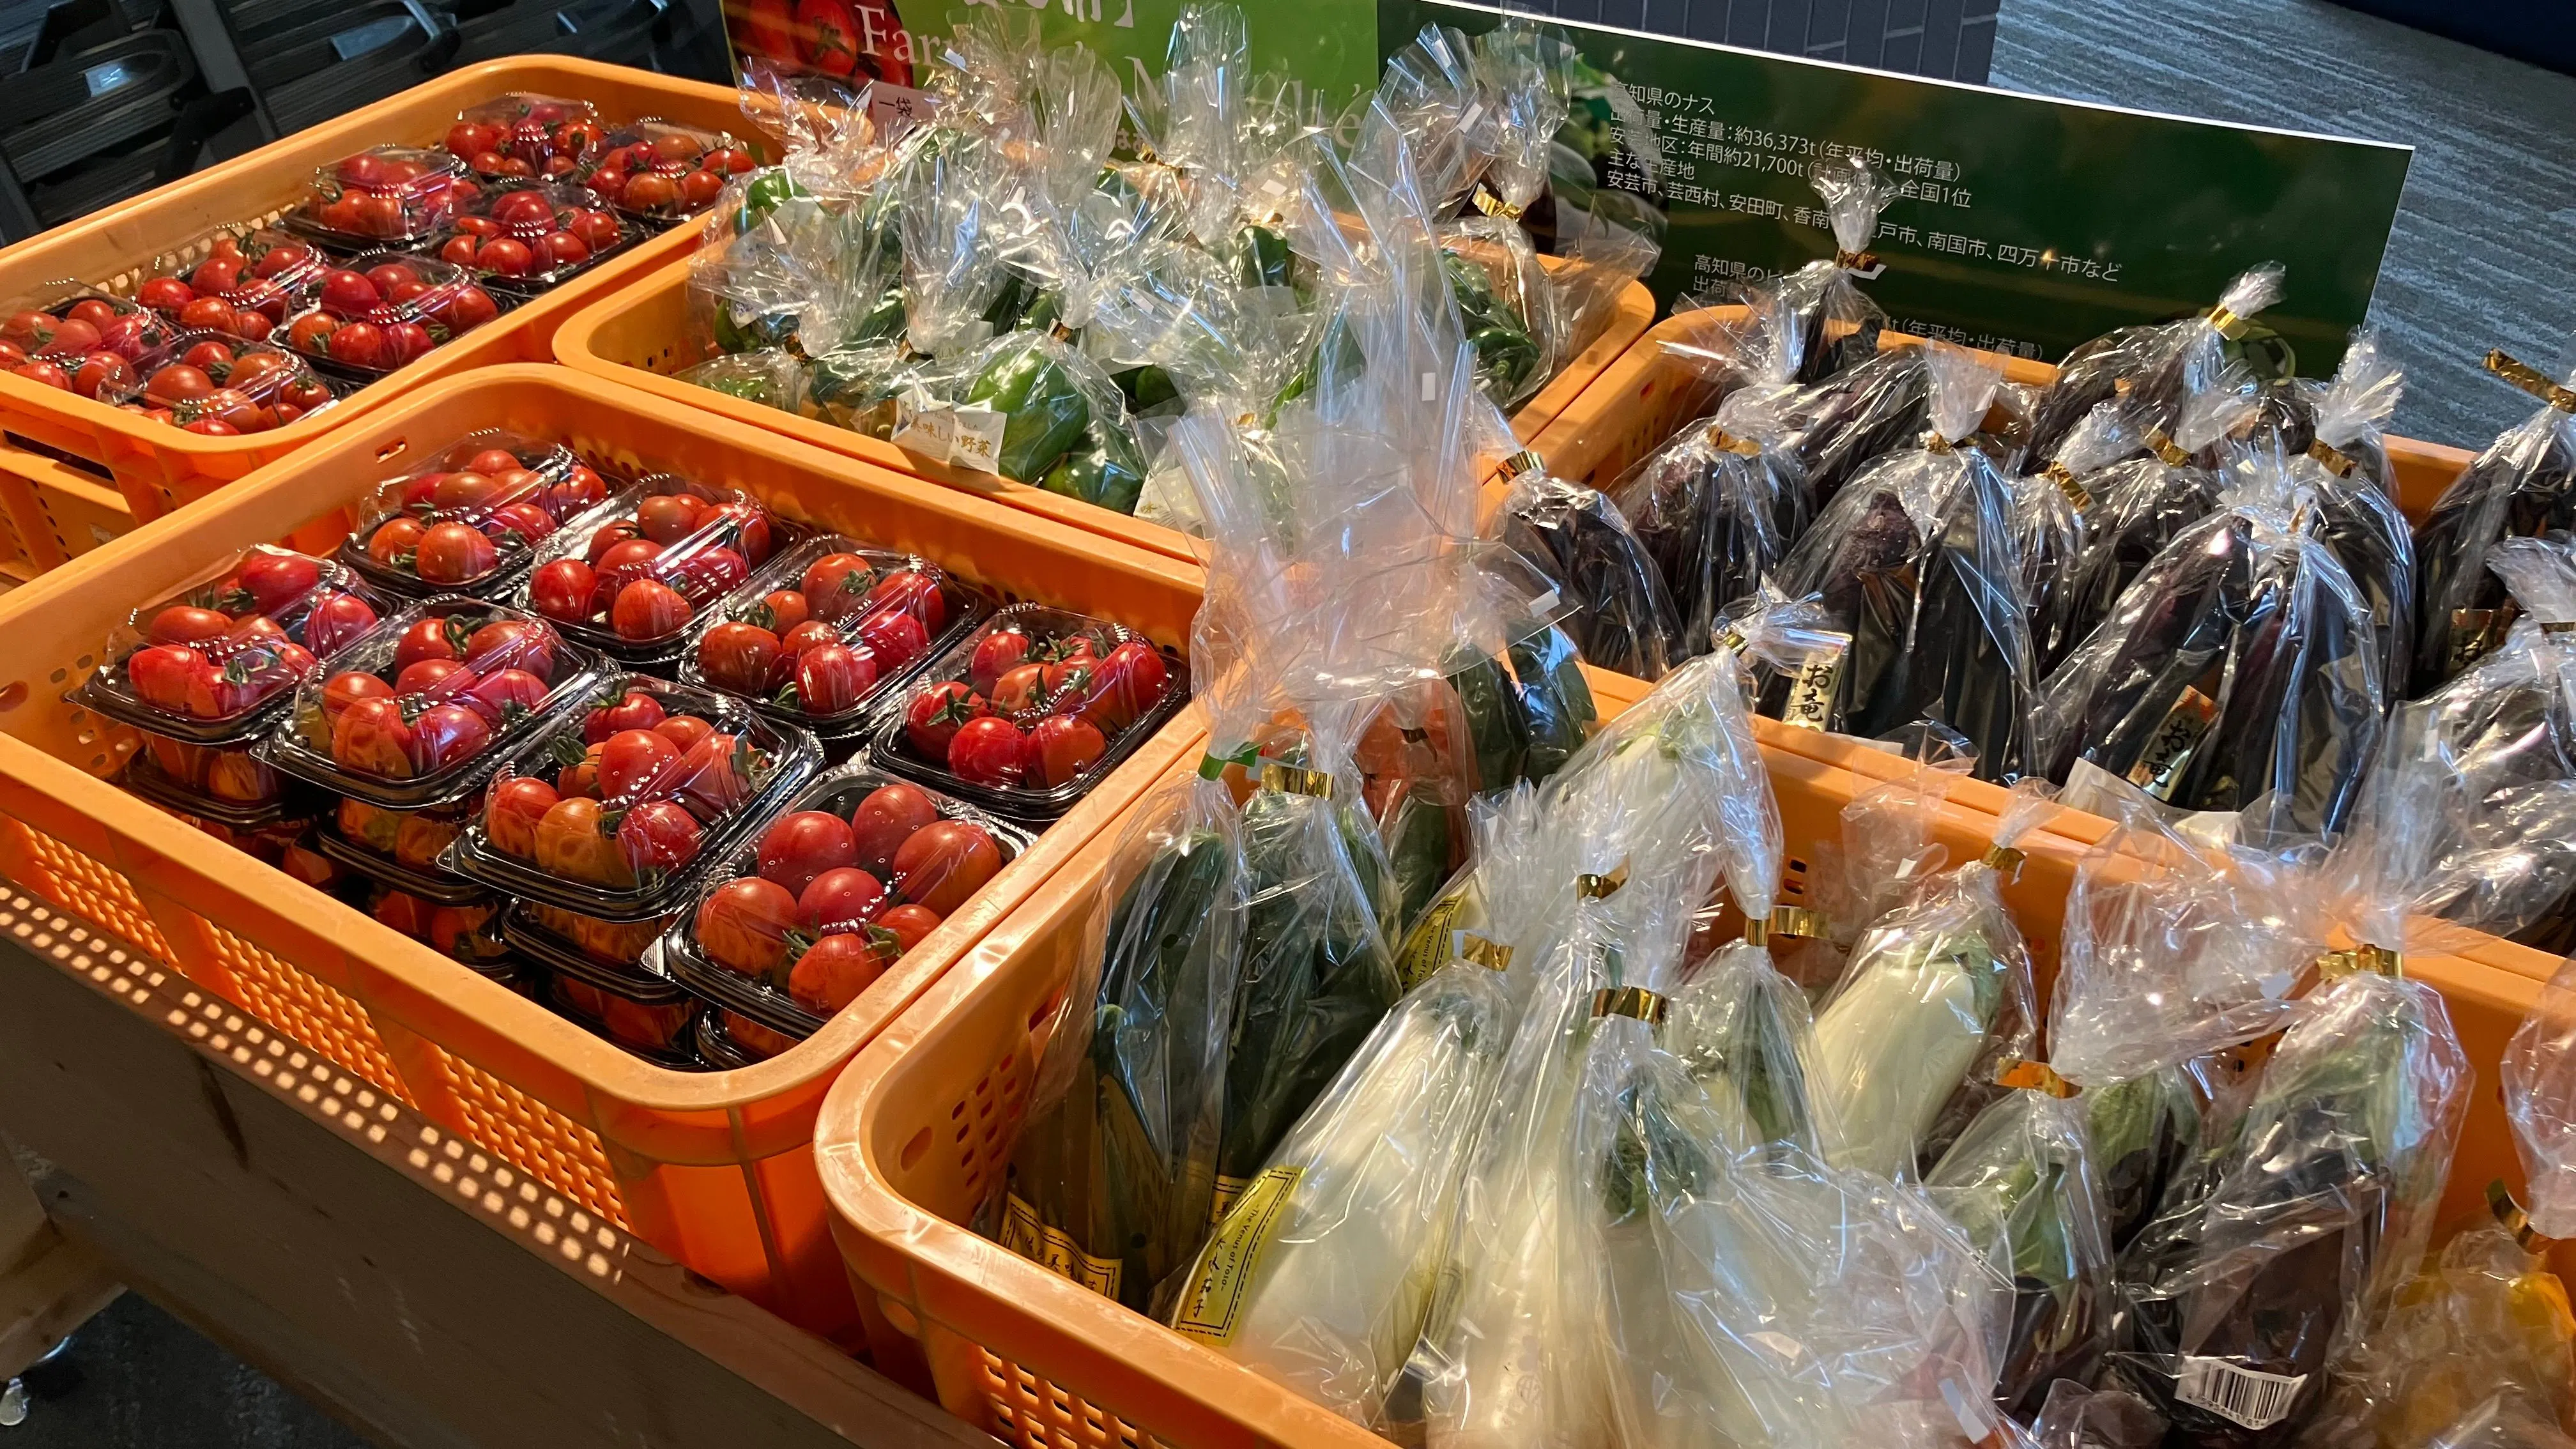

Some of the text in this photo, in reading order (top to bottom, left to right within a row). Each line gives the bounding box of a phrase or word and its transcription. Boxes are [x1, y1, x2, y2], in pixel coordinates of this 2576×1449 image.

[854, 4, 957, 66] Far
[1614, 81, 1715, 116] 高知県のナス
[1607, 148, 1695, 181] 主な生産地
[1232, 1225, 1250, 1250] Venus
